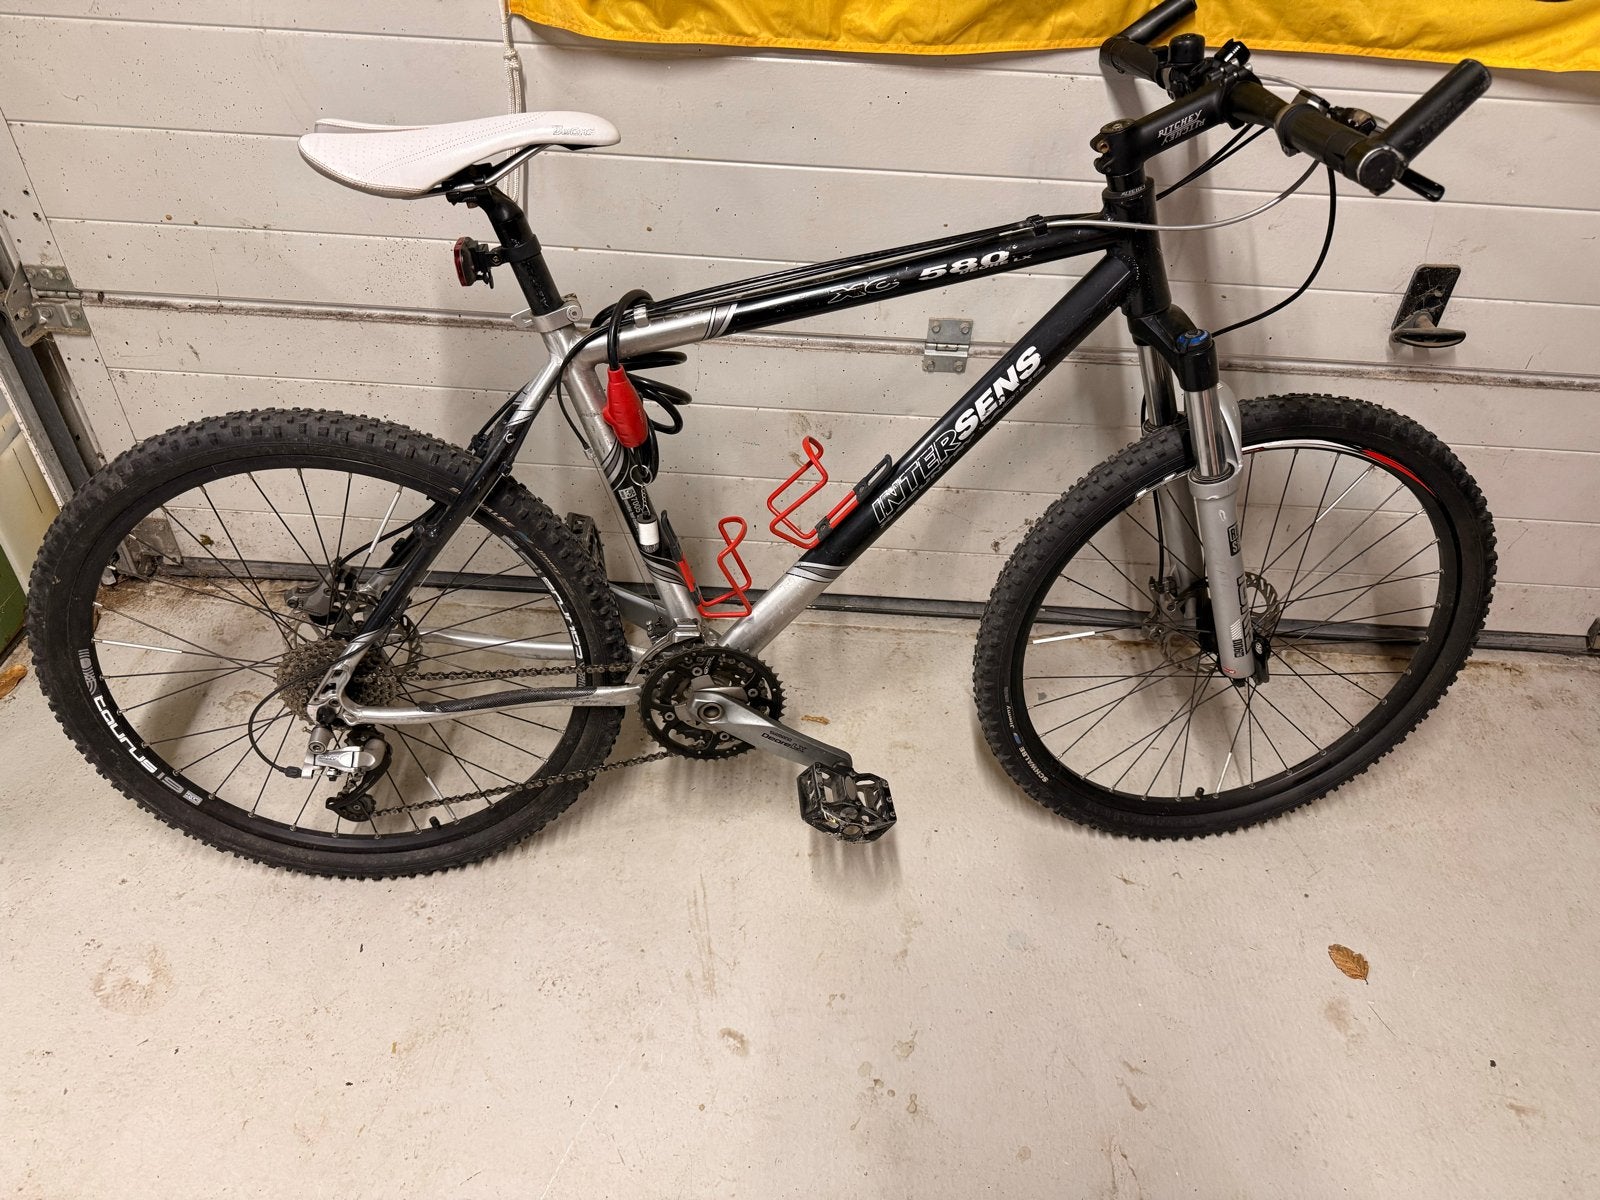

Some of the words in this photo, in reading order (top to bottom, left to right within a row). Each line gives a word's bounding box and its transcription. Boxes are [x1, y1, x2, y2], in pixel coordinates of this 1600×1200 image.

[1157, 109, 1203, 138] RITCHEY
[918, 250, 1010, 281] 580
[871, 345, 1042, 524] INTERSENS
[630, 496, 643, 514] 7005
[1005, 704, 1015, 729] Jimmy
[93, 694, 159, 775] taurus
[1018, 745, 1050, 784] SCHWALBE
